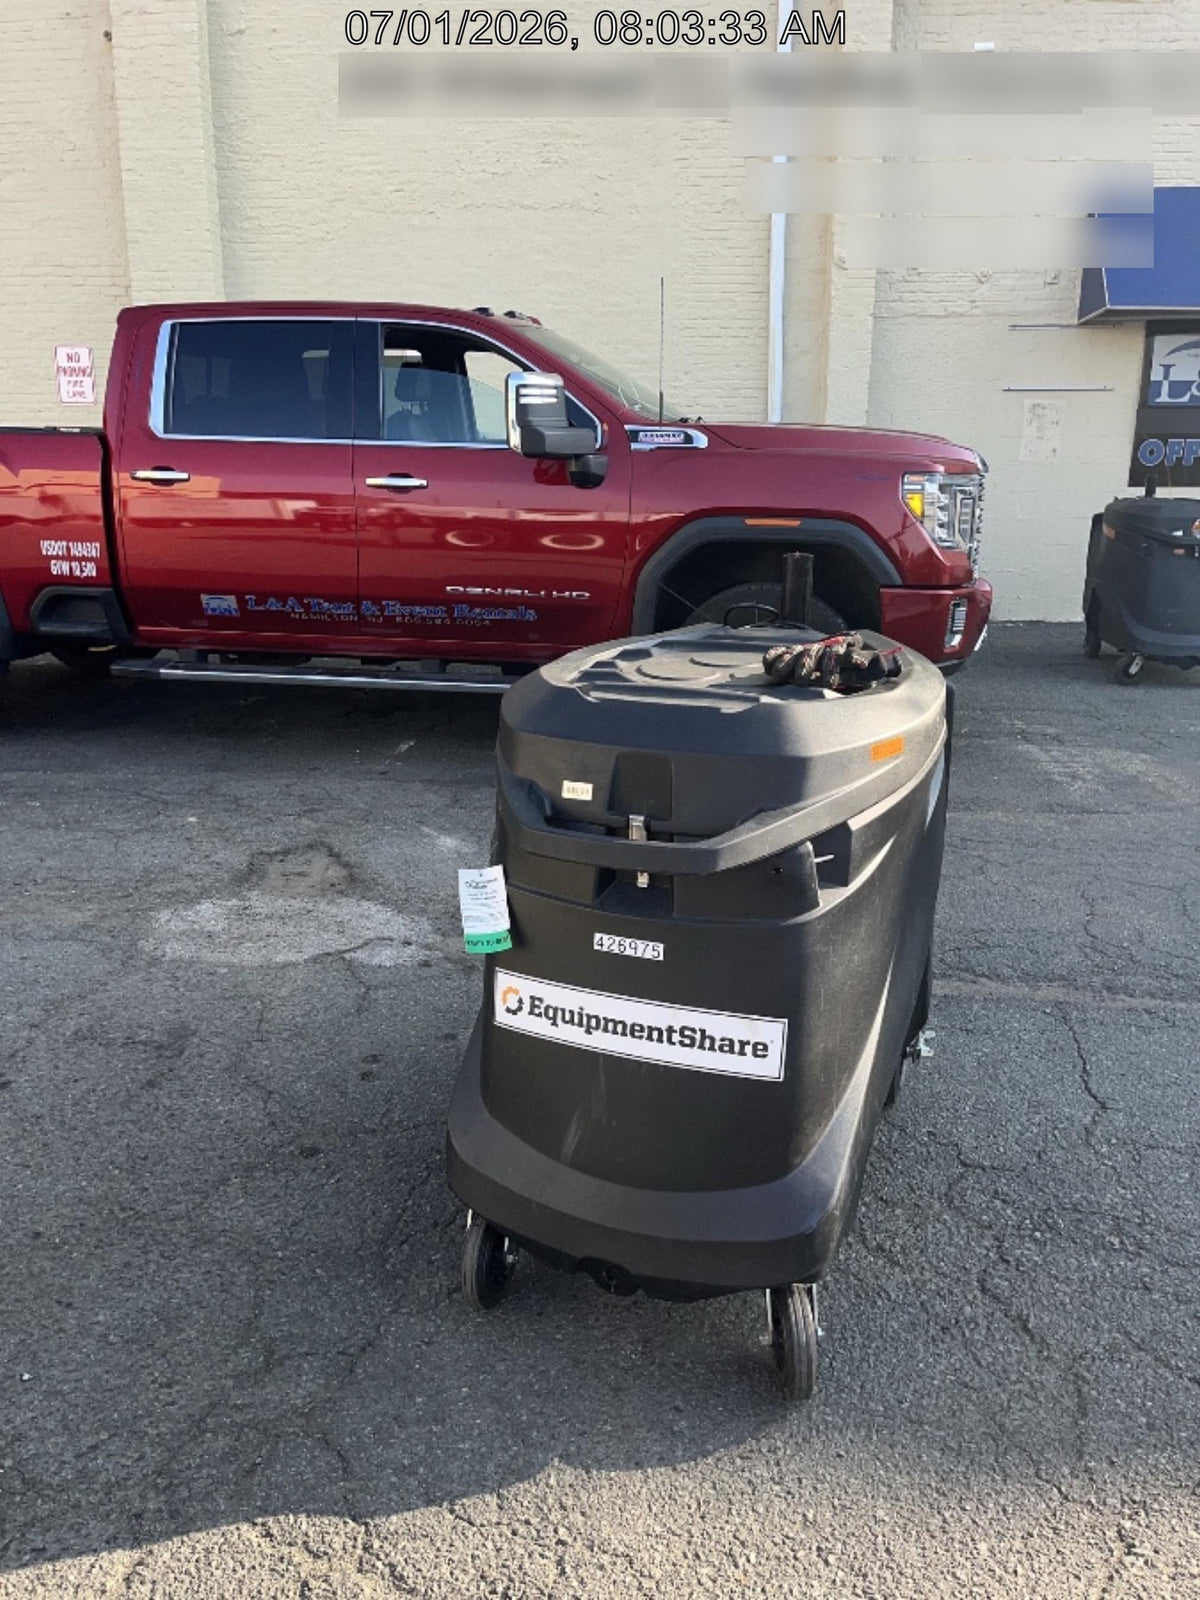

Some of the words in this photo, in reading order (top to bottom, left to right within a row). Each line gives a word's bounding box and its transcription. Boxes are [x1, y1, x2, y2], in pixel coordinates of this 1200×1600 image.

[66, 352, 80, 363] NO
[40, 540, 67, 556] USDOT
[446, 586, 545, 597] DENALI
[553, 590, 591, 600] HD
[304, 598, 356, 614] Tent
[361, 600, 380, 615] &
[382, 601, 447, 617] Event
[453, 604, 538, 621] Rentals
[594, 933, 661, 961] 426975
[527, 994, 770, 1059] EquipmentShare
